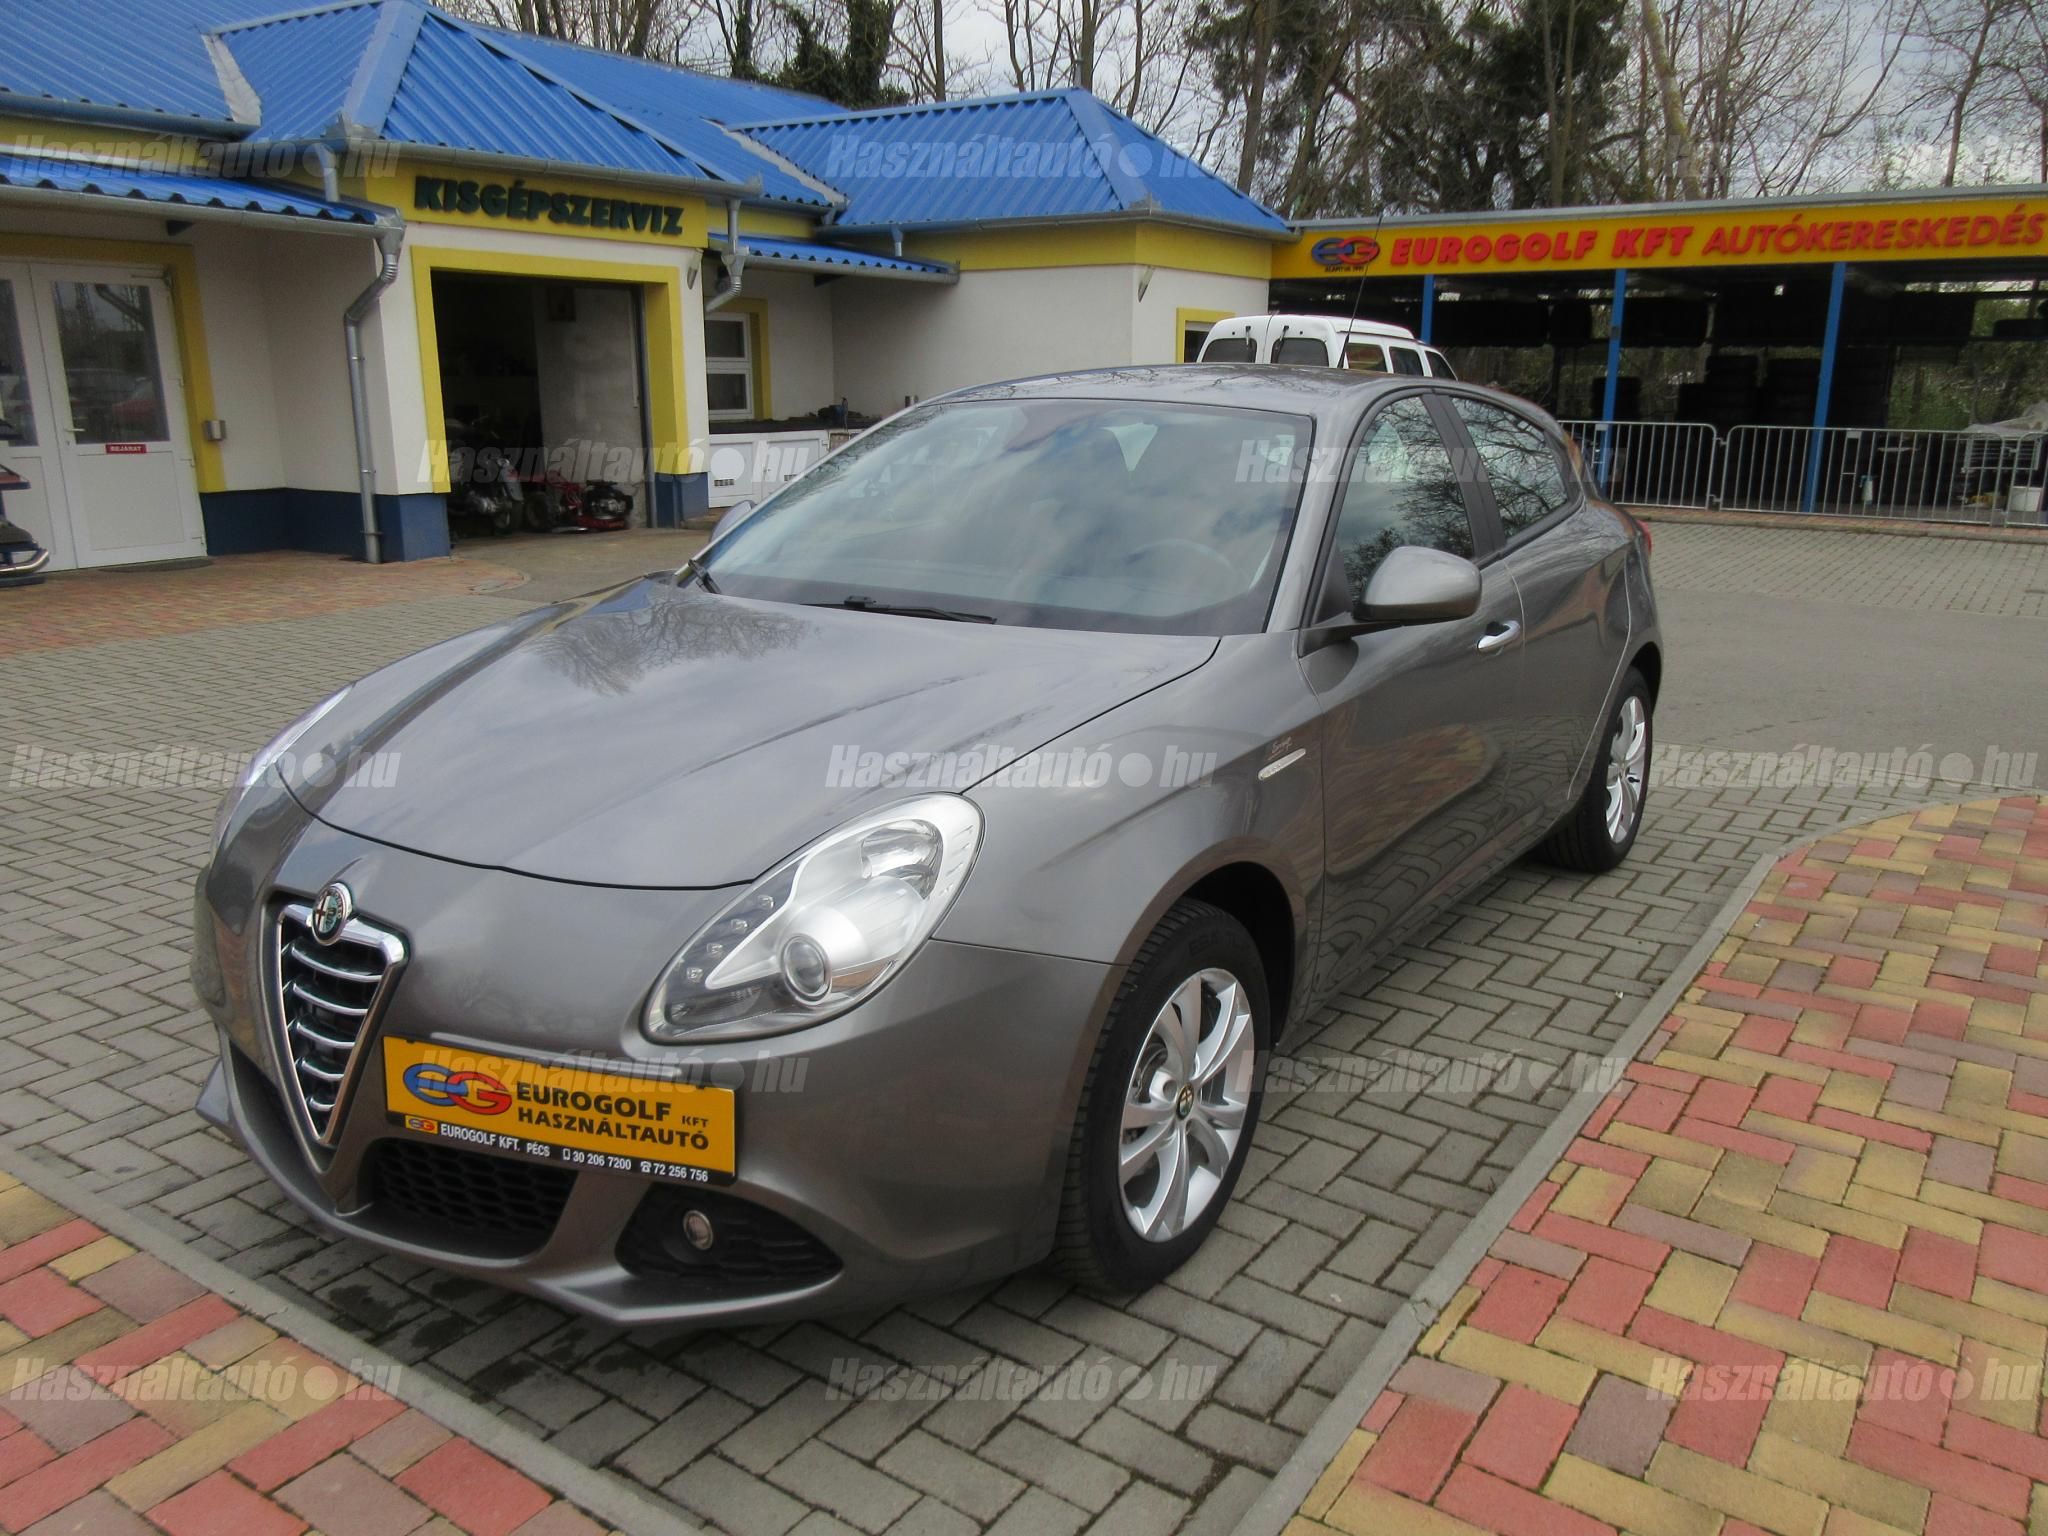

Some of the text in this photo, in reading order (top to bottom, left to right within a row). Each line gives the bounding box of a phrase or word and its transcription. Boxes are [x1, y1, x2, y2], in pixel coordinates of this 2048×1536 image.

[414, 176, 684, 235] KISGÉPSZERVIZ
[1389, 230, 1598, 265] EUROGOLF
[1610, 226, 1695, 259] KFT
[1701, 204, 2046, 256] AUTÓKERESKEDÉS
[516, 1081, 709, 1129] EUROGOLF KFT
[518, 1107, 710, 1151] HASZNÁLTAUTÓ
[440, 1123, 497, 1146] EUROGOLF
[526, 1141, 551, 1157] PÉCS
[573, 1151, 585, 1163] 30
[587, 1153, 605, 1167] 206
[607, 1156, 632, 1170] 7200
[653, 1162, 666, 1176] 72
[668, 1165, 687, 1179] 256
[689, 1168, 709, 1182] 756
